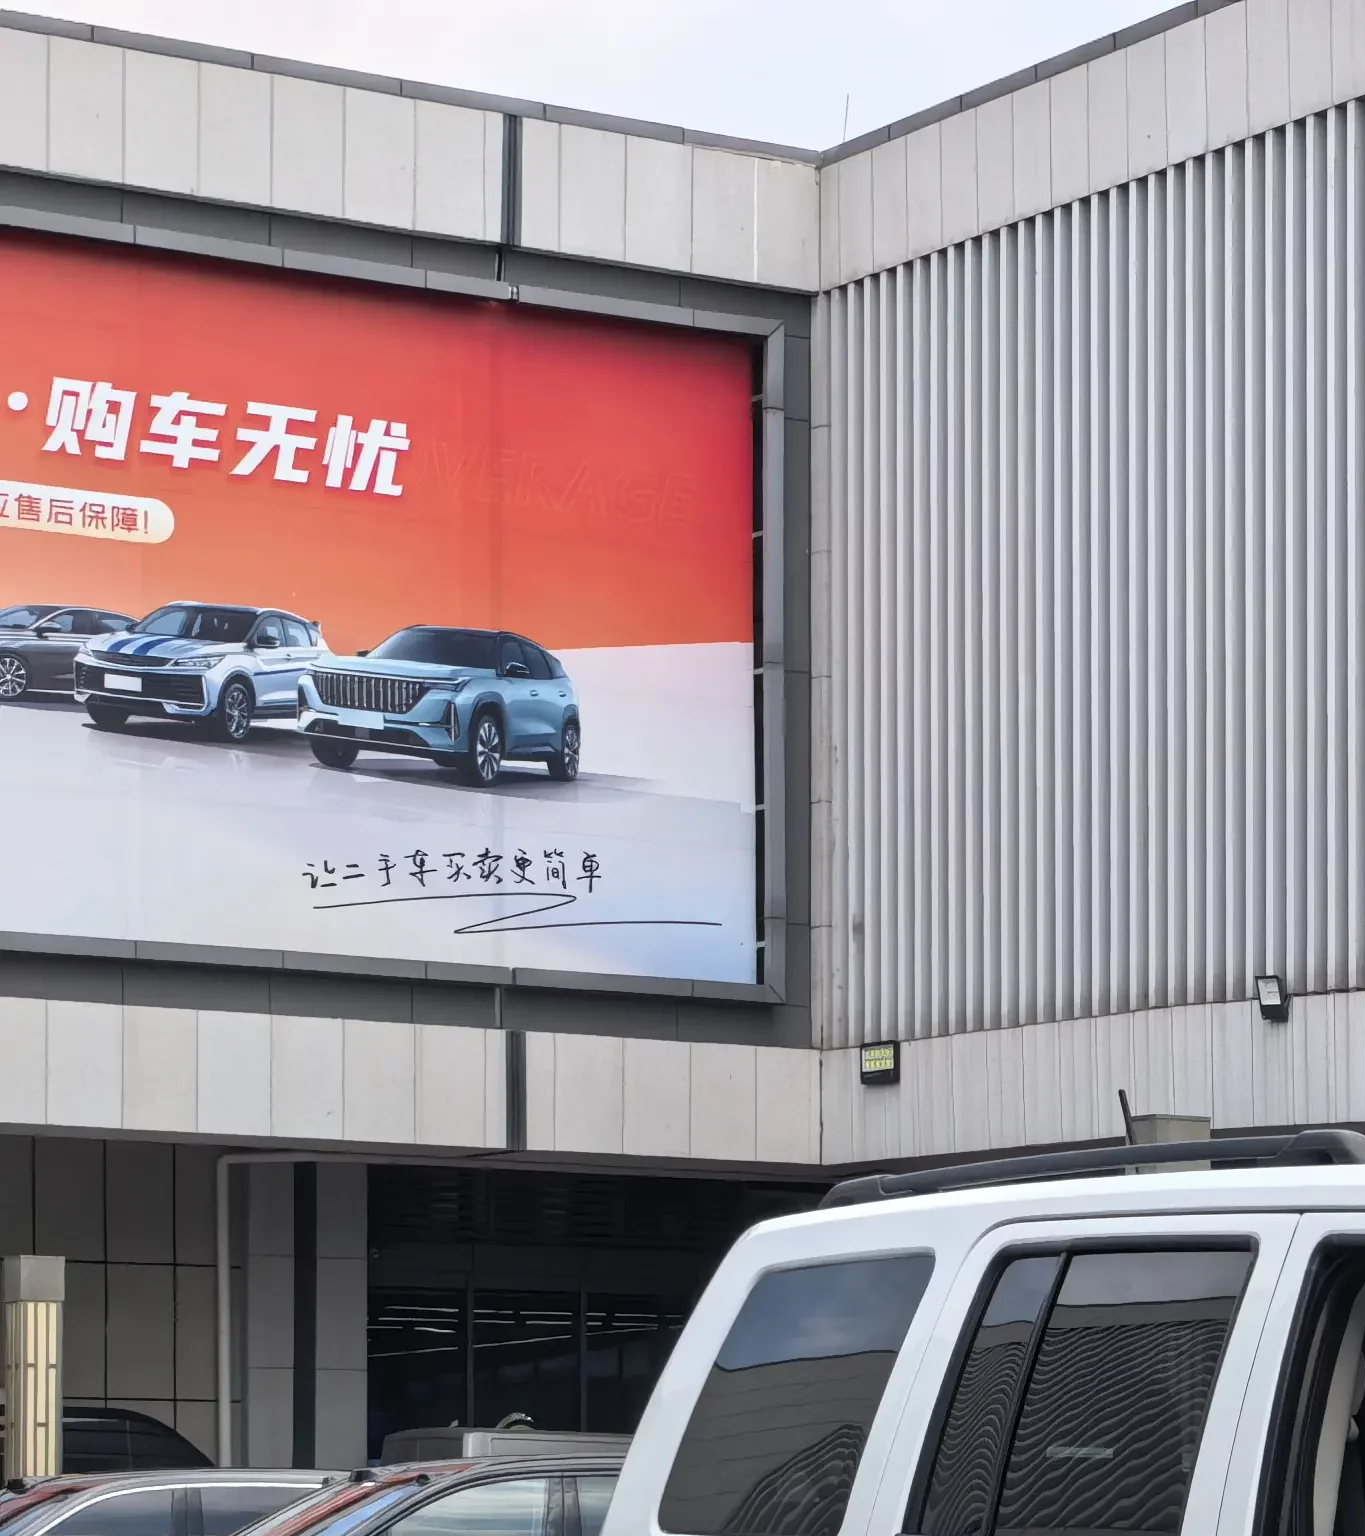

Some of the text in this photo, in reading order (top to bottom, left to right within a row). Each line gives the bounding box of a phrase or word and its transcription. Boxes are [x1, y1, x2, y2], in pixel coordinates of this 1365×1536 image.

[302, 848, 602, 893] 让二手车买卖更简单
